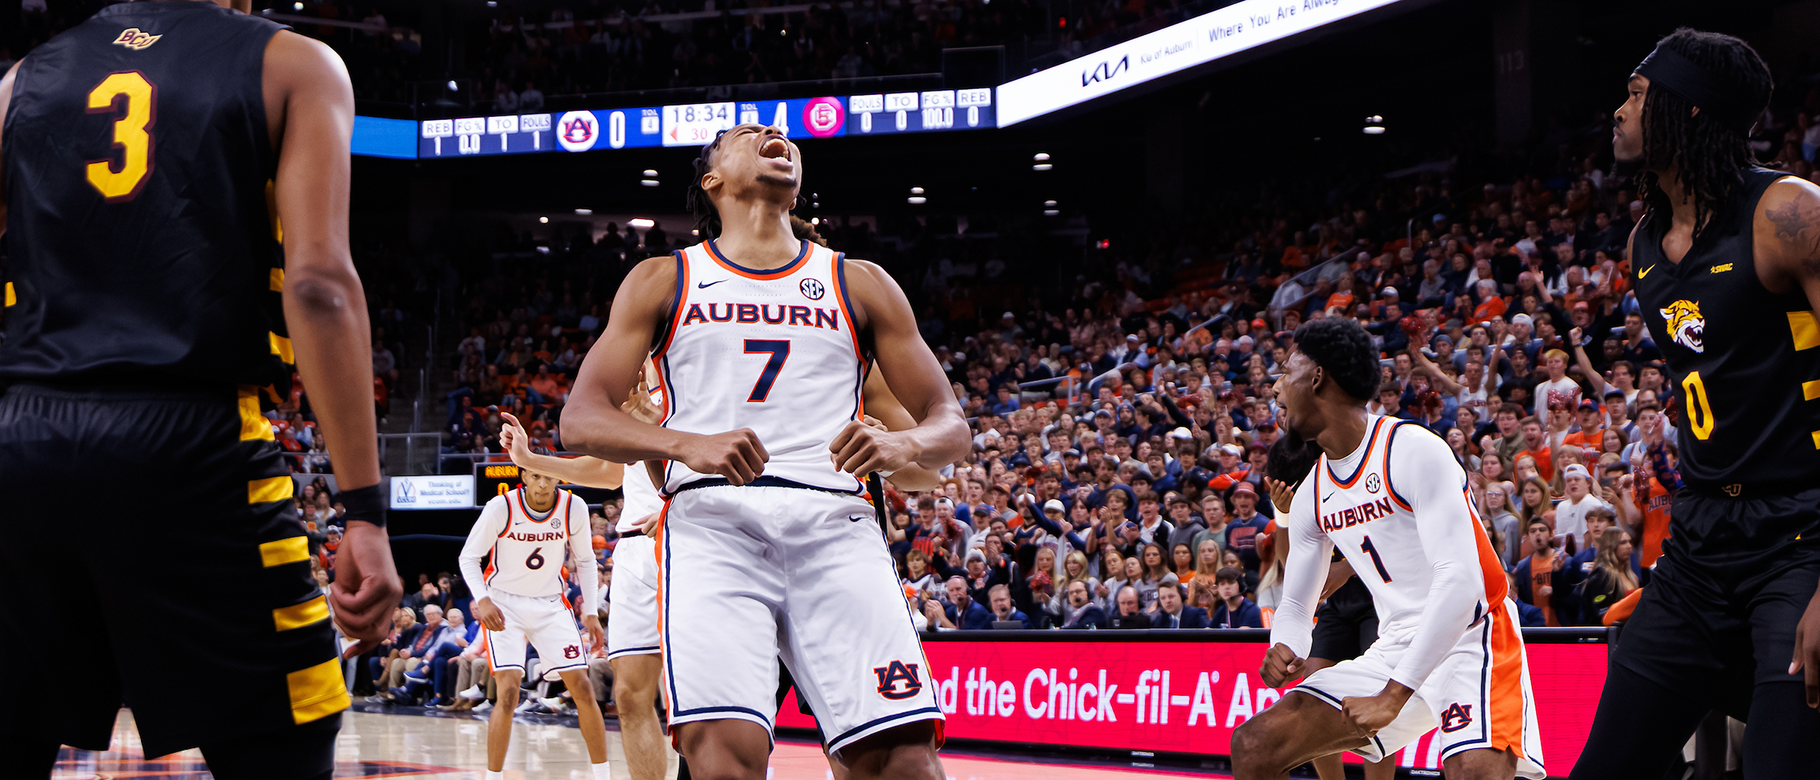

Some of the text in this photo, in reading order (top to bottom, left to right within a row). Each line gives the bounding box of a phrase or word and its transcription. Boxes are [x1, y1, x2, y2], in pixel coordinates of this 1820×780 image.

[1209, 22, 1243, 42] Where
[1249, 14, 1271, 29] You
[1277, 5, 1296, 20] Are
[852, 98, 882, 109] FOULS
[892, 96, 911, 107] TO
[960, 92, 986, 103] REB
[495, 119, 511, 129] TO
[523, 117, 550, 127] FOULS
[673, 104, 728, 123] 18:34
[772, 101, 790, 138] 4
[861, 111, 872, 133] 0
[895, 109, 907, 131] 0
[922, 107, 954, 129] 100.0
[967, 105, 979, 128] 0
[85, 70, 157, 203] 3
[427, 122, 450, 133] REB
[609, 111, 626, 149] 0
[691, 127, 708, 140] 30
[434, 135, 442, 156] 1
[501, 132, 508, 153] 1
[533, 130, 540, 151] 1
[800, 278, 825, 301] SEC
[682, 302, 840, 332] AUBURN
[743, 338, 791, 403] 7
[1682, 370, 1716, 441] 0
[485, 465, 519, 478] AUBURN
[1366, 472, 1381, 494] SEC
[1323, 497, 1394, 533] AUBURN
[507, 531, 564, 542] AUBURN
[525, 547, 545, 570] 6
[1360, 535, 1393, 584] 1
[965, 666, 1016, 717] the
